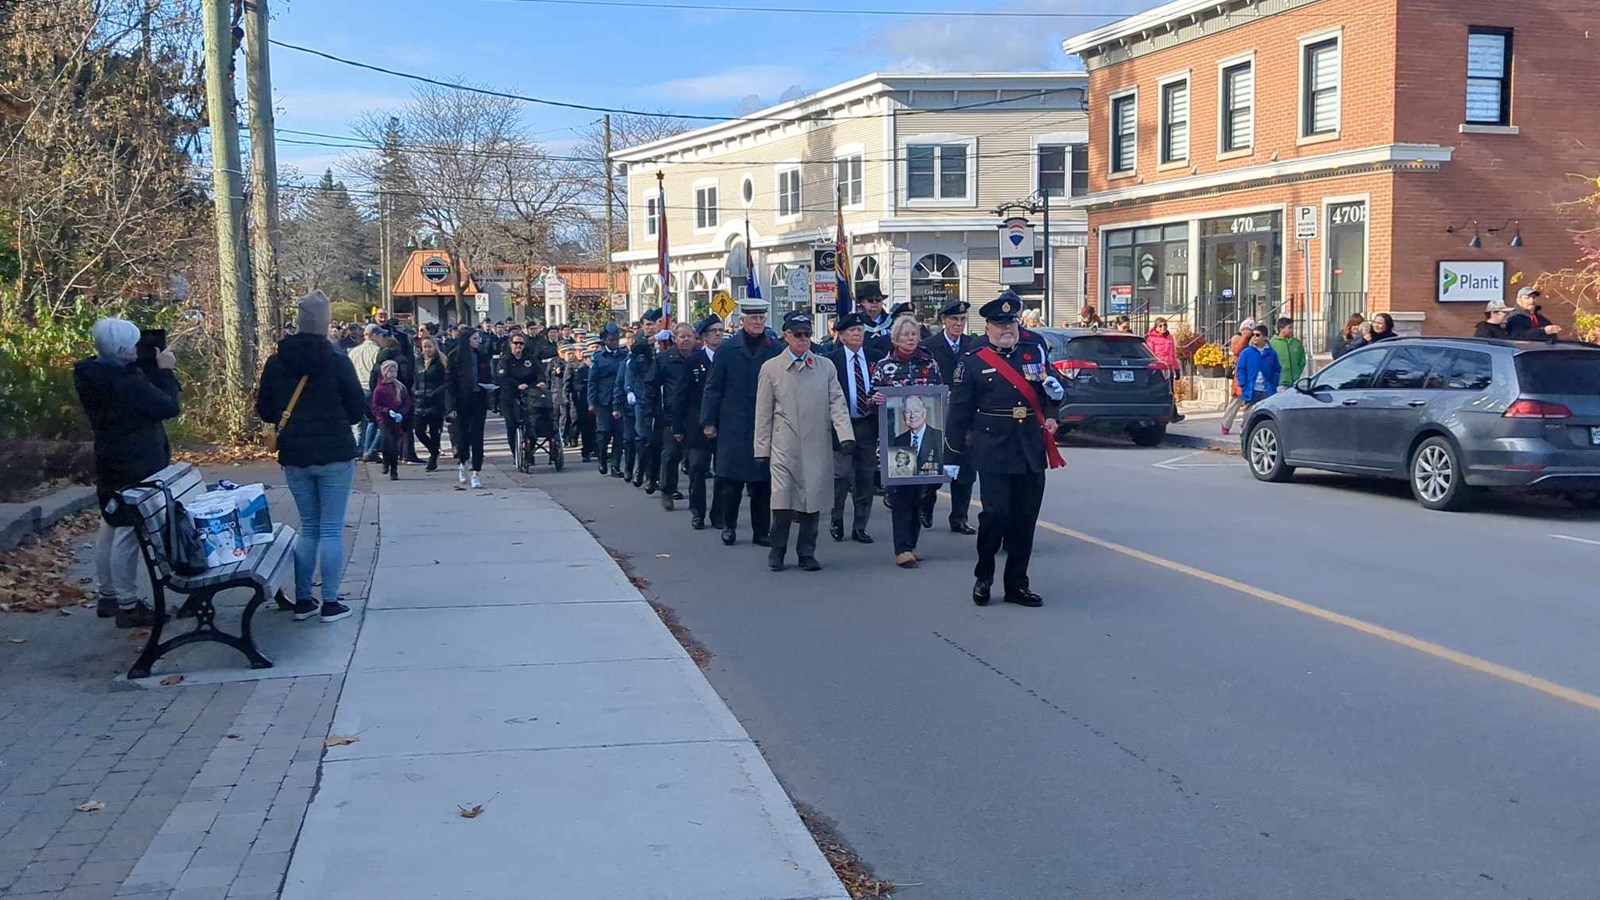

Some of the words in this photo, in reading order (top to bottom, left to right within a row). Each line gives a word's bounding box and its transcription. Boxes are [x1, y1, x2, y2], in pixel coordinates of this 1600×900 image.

[1302, 208, 1311, 220] P
[1231, 216, 1253, 234] 470
[1460, 274, 1499, 289] Planit
